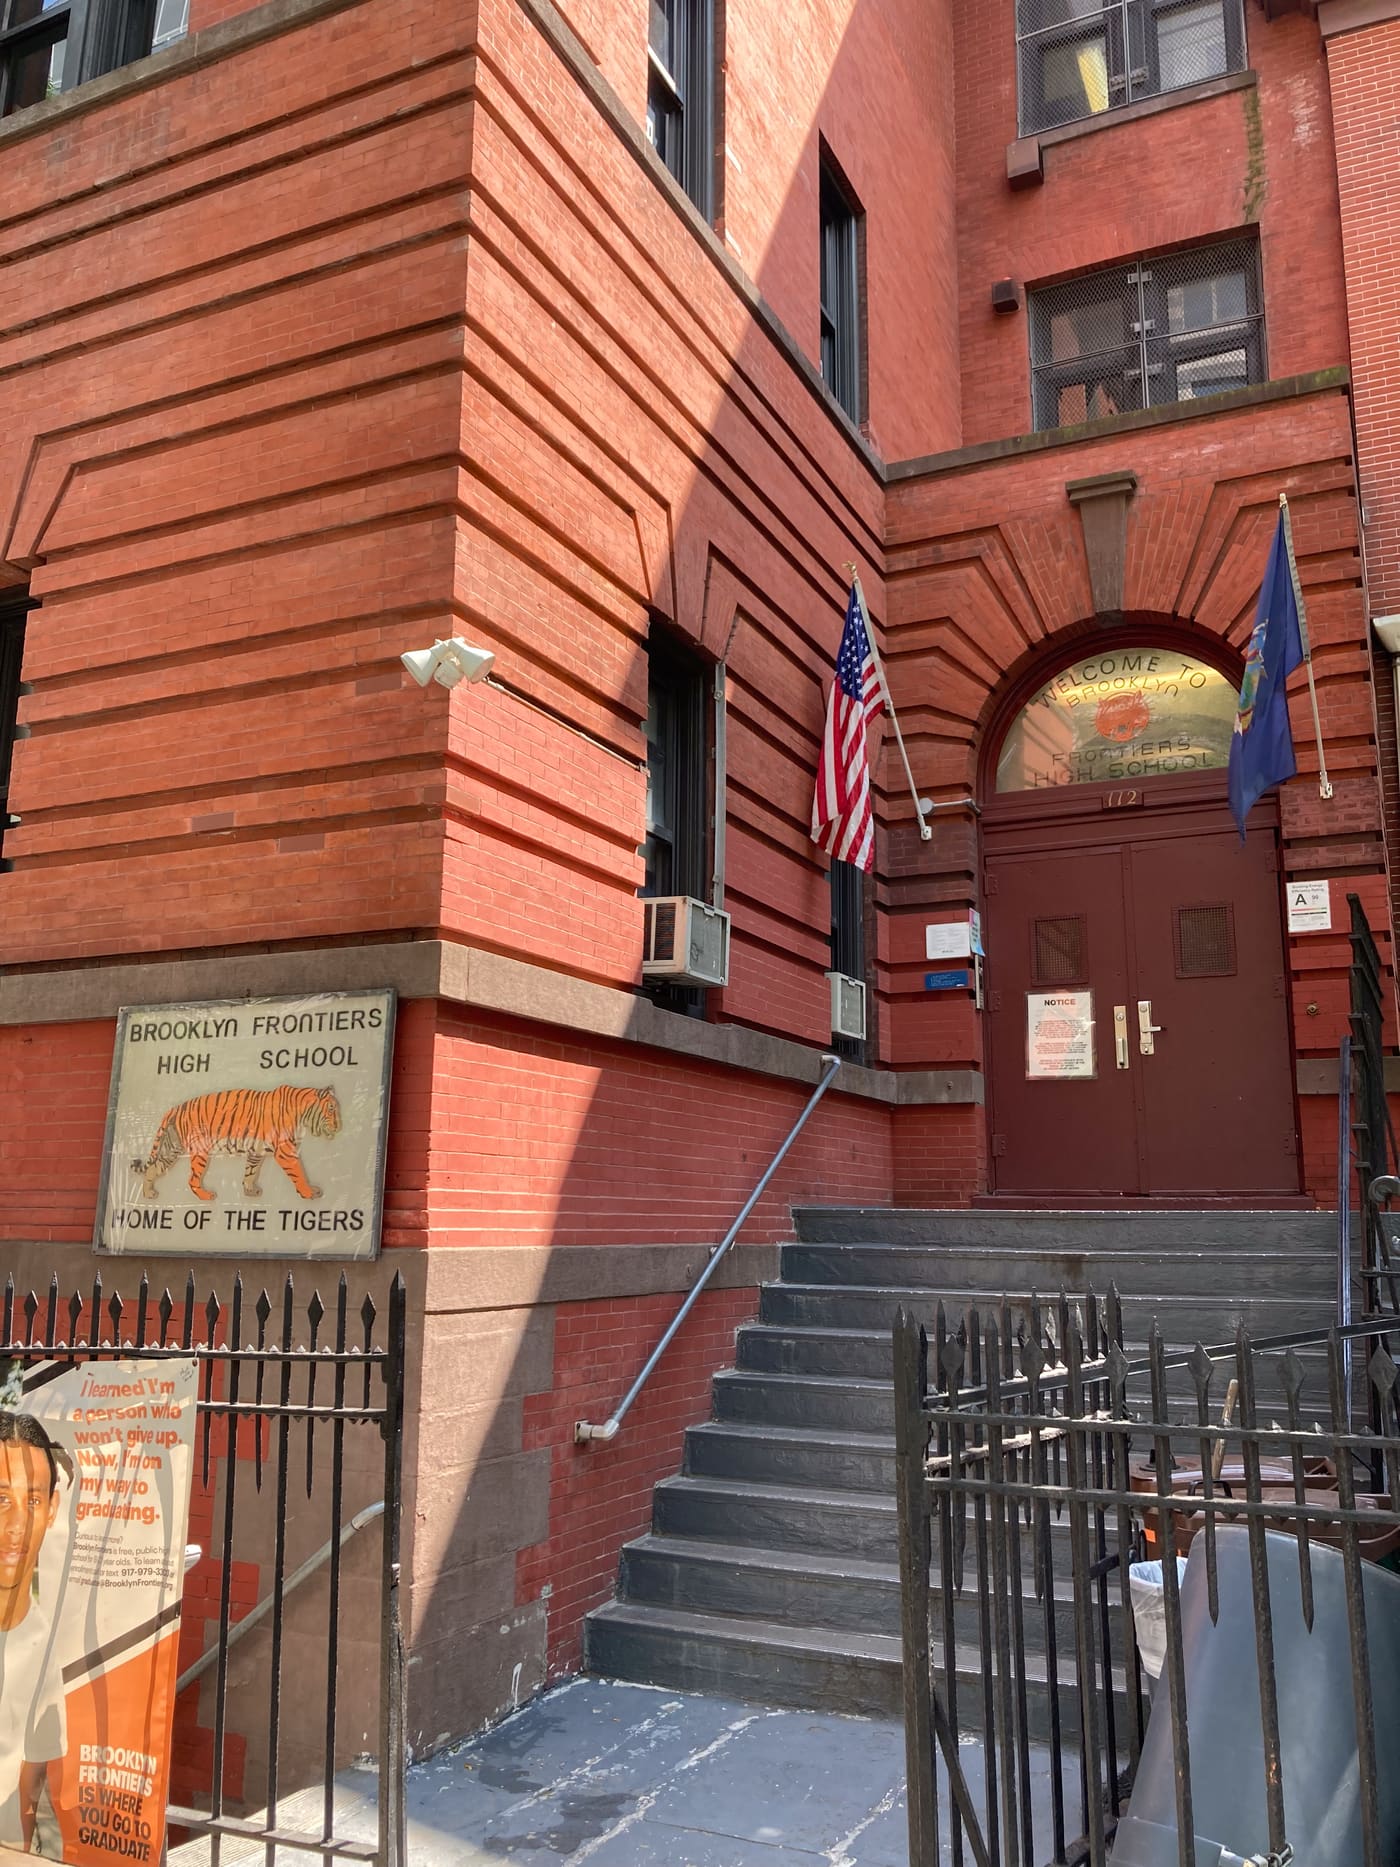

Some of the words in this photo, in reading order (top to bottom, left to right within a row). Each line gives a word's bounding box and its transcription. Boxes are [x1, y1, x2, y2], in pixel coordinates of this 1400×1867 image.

[1036, 656, 1161, 709] WELCOME
[1178, 663, 1207, 689] TO
[1034, 766, 1093, 787] HIGH
[1108, 752, 1214, 778] SCHOOL
[1108, 790, 1137, 807] 112
[1295, 893, 1307, 906] A
[1044, 998, 1077, 1006] NOTICE
[157, 1053, 211, 1075] HIGH
[259, 1046, 359, 1070] SCHOOL
[112, 1209, 173, 1230] HOME
[183, 1210, 212, 1230] OF
[224, 1210, 267, 1231] THE
[278, 1209, 364, 1231] TIGERS
[80, 1379, 88, 1397] I
[88, 1378, 145, 1398] learned
[147, 1378, 175, 1395] I'm
[72, 1408, 83, 1421] a
[85, 1405, 147, 1425] person
[74, 1427, 123, 1443] won't
[127, 1425, 154, 1448] give
[155, 1430, 183, 1449] up.
[77, 1450, 118, 1471] Now,
[122, 1449, 141, 1468] I'm
[142, 1455, 162, 1469] on
[80, 1477, 101, 1497] my
[106, 1478, 131, 1499] way
[132, 1478, 149, 1495] to
[76, 1499, 160, 1525] graduating.
[135, 1545, 158, 1556] public
[80, 1744, 157, 1775] BROOKLYN
[79, 1765, 153, 1797] FRONTIERS
[79, 1785, 95, 1804] IS
[98, 1786, 144, 1817] WHERE
[79, 1806, 110, 1828] YOU
[112, 1813, 131, 1835] GO
[133, 1820, 151, 1840] TO
[79, 1826, 151, 1862] GRADUATE
